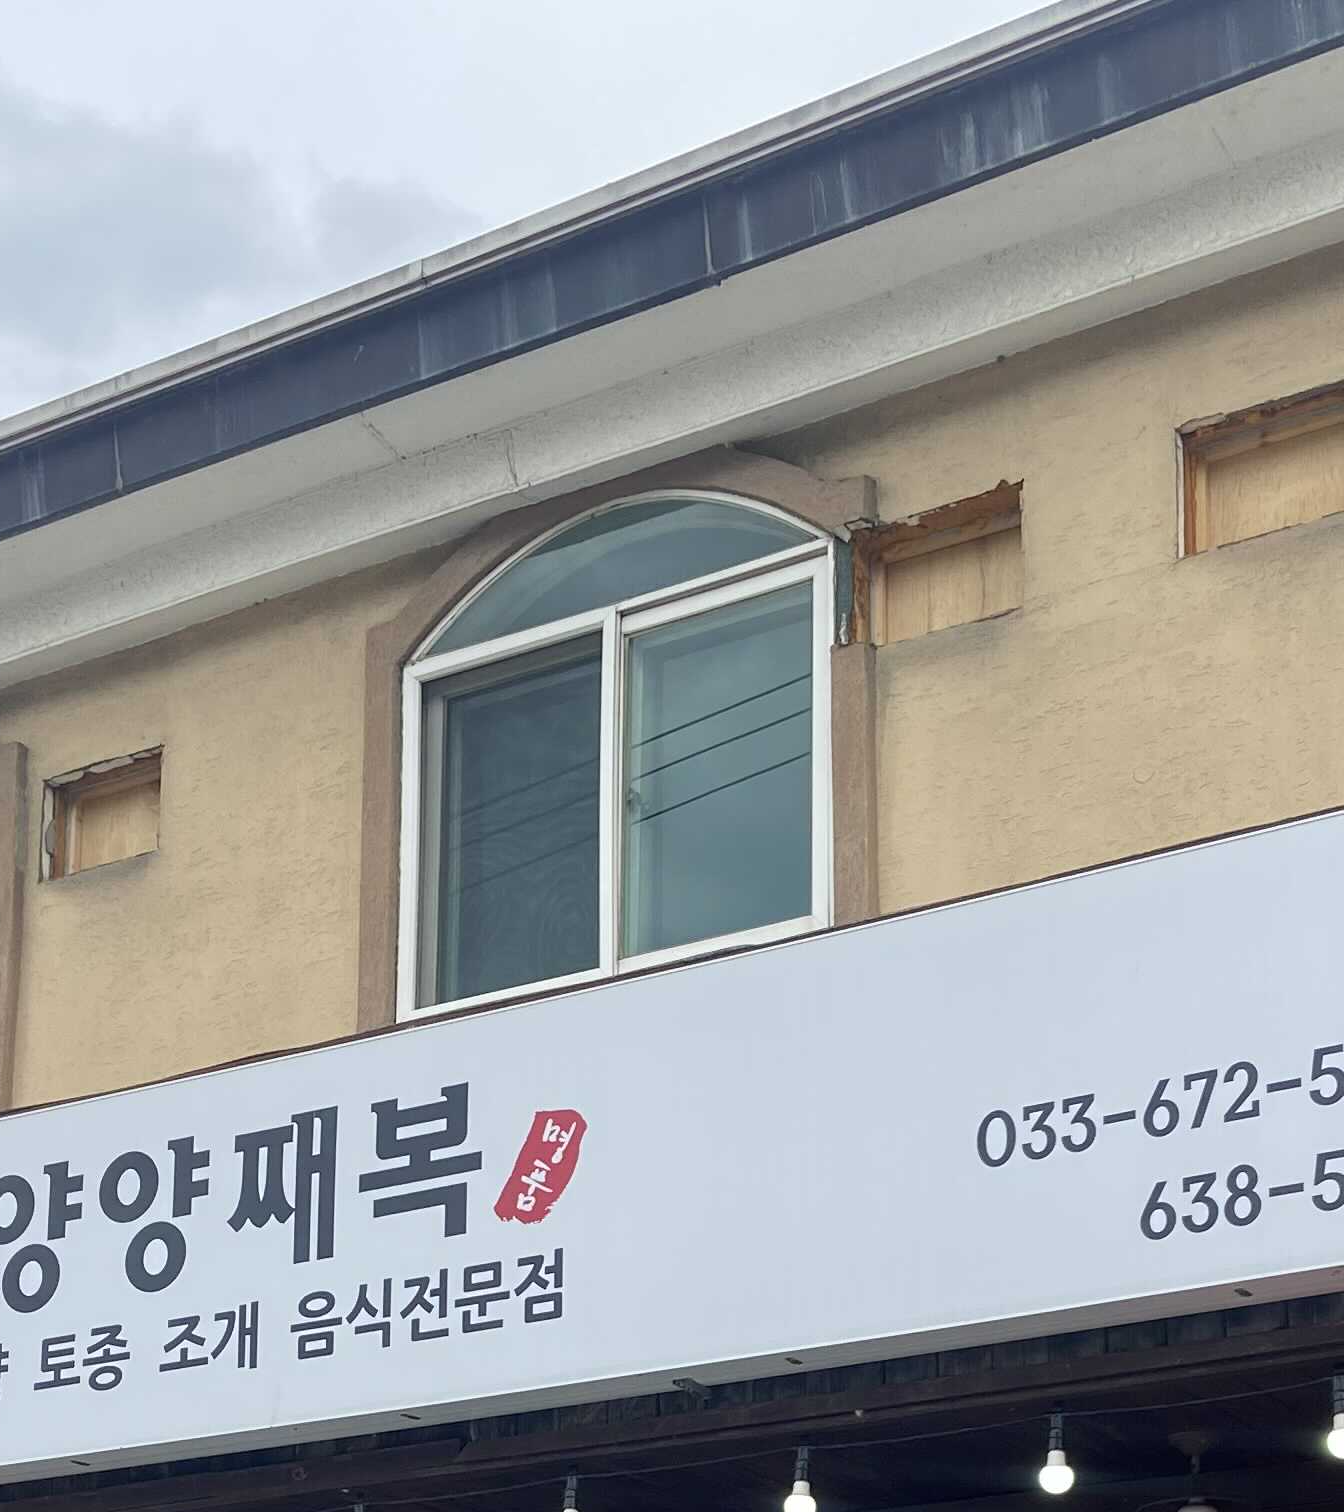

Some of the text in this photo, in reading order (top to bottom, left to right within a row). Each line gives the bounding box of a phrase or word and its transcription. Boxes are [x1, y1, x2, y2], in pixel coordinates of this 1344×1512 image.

[517, 1118, 576, 1211] 명품
[34, 1324, 130, 1391] 토종
[159, 1301, 258, 1372] 조개
[290, 1248, 565, 1360] 음식전문점
